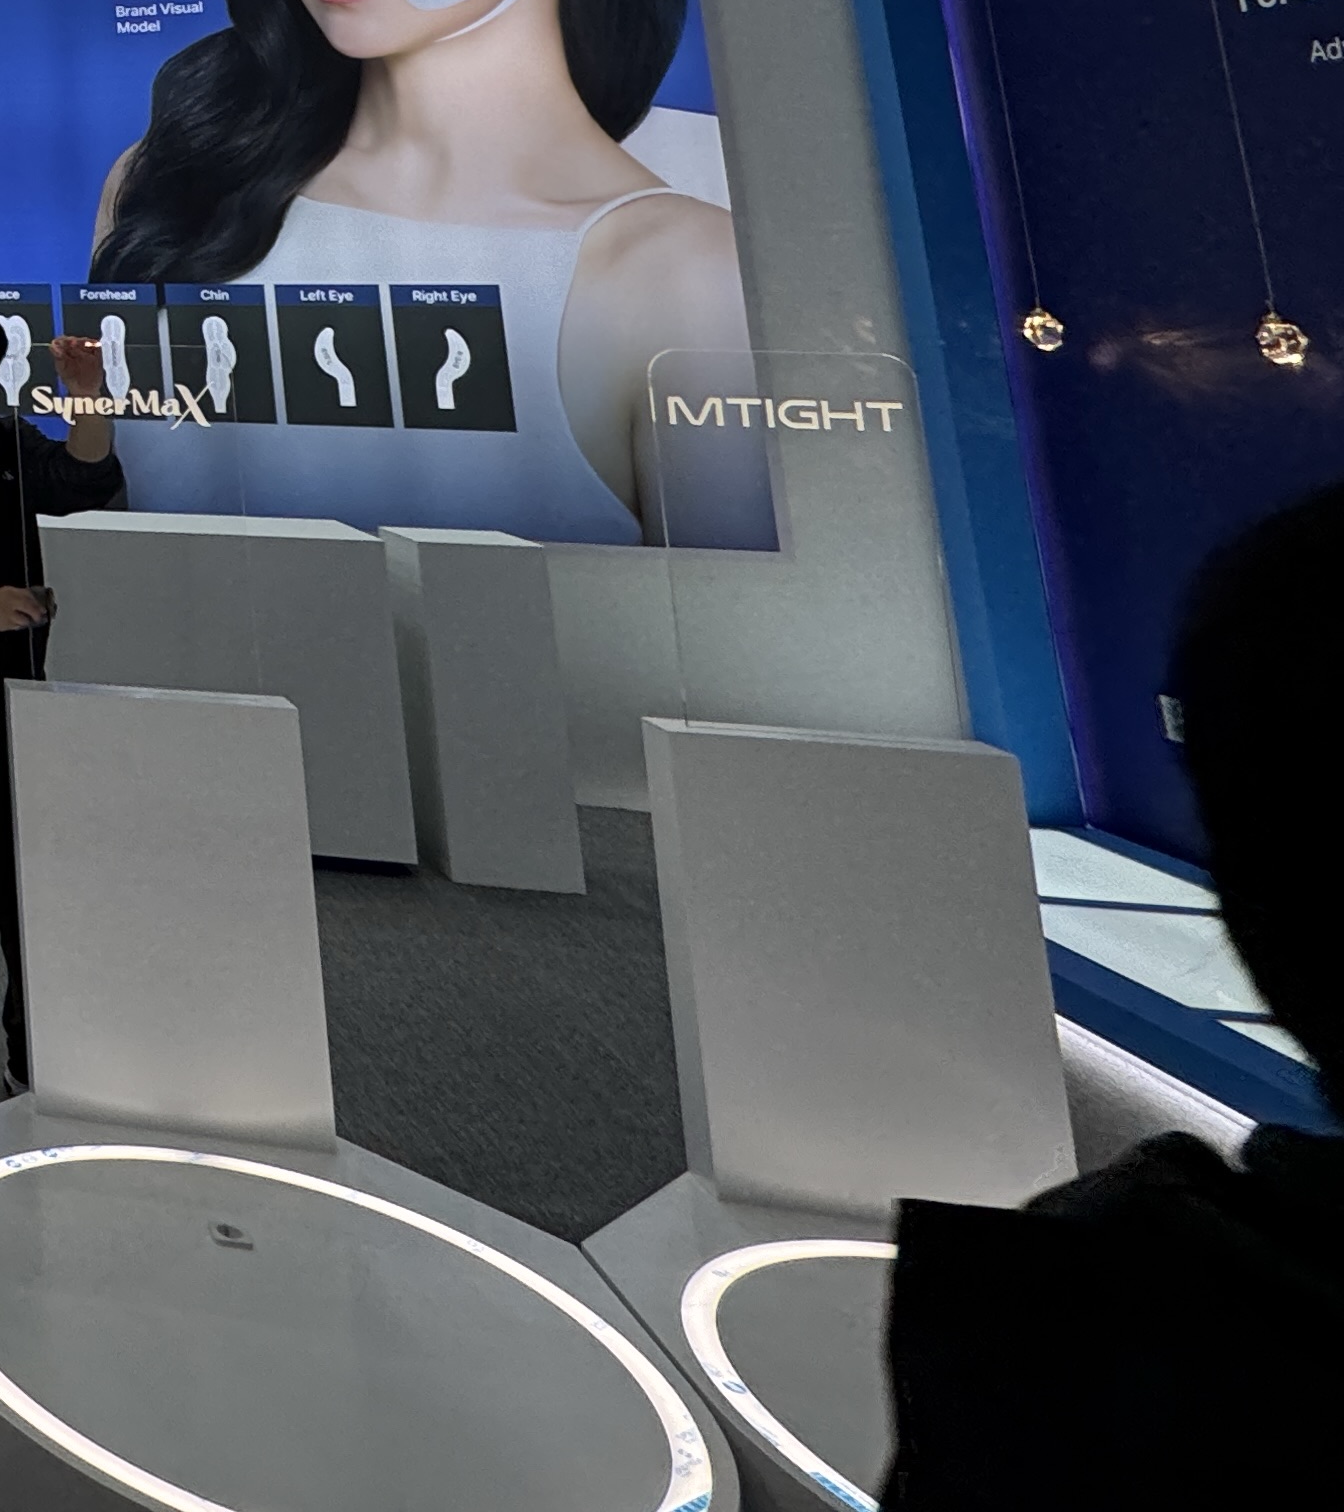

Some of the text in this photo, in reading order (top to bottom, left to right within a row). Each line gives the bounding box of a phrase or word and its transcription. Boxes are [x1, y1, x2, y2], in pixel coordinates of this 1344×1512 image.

[115, 0, 204, 18] Brand Visual
[116, 19, 162, 34] Model
[79, 288, 137, 302] Forehead
[200, 288, 231, 302] Chin
[299, 289, 355, 305] Left Eye
[412, 289, 478, 305] Right Eye
[667, 395, 904, 432] MTIGHT
